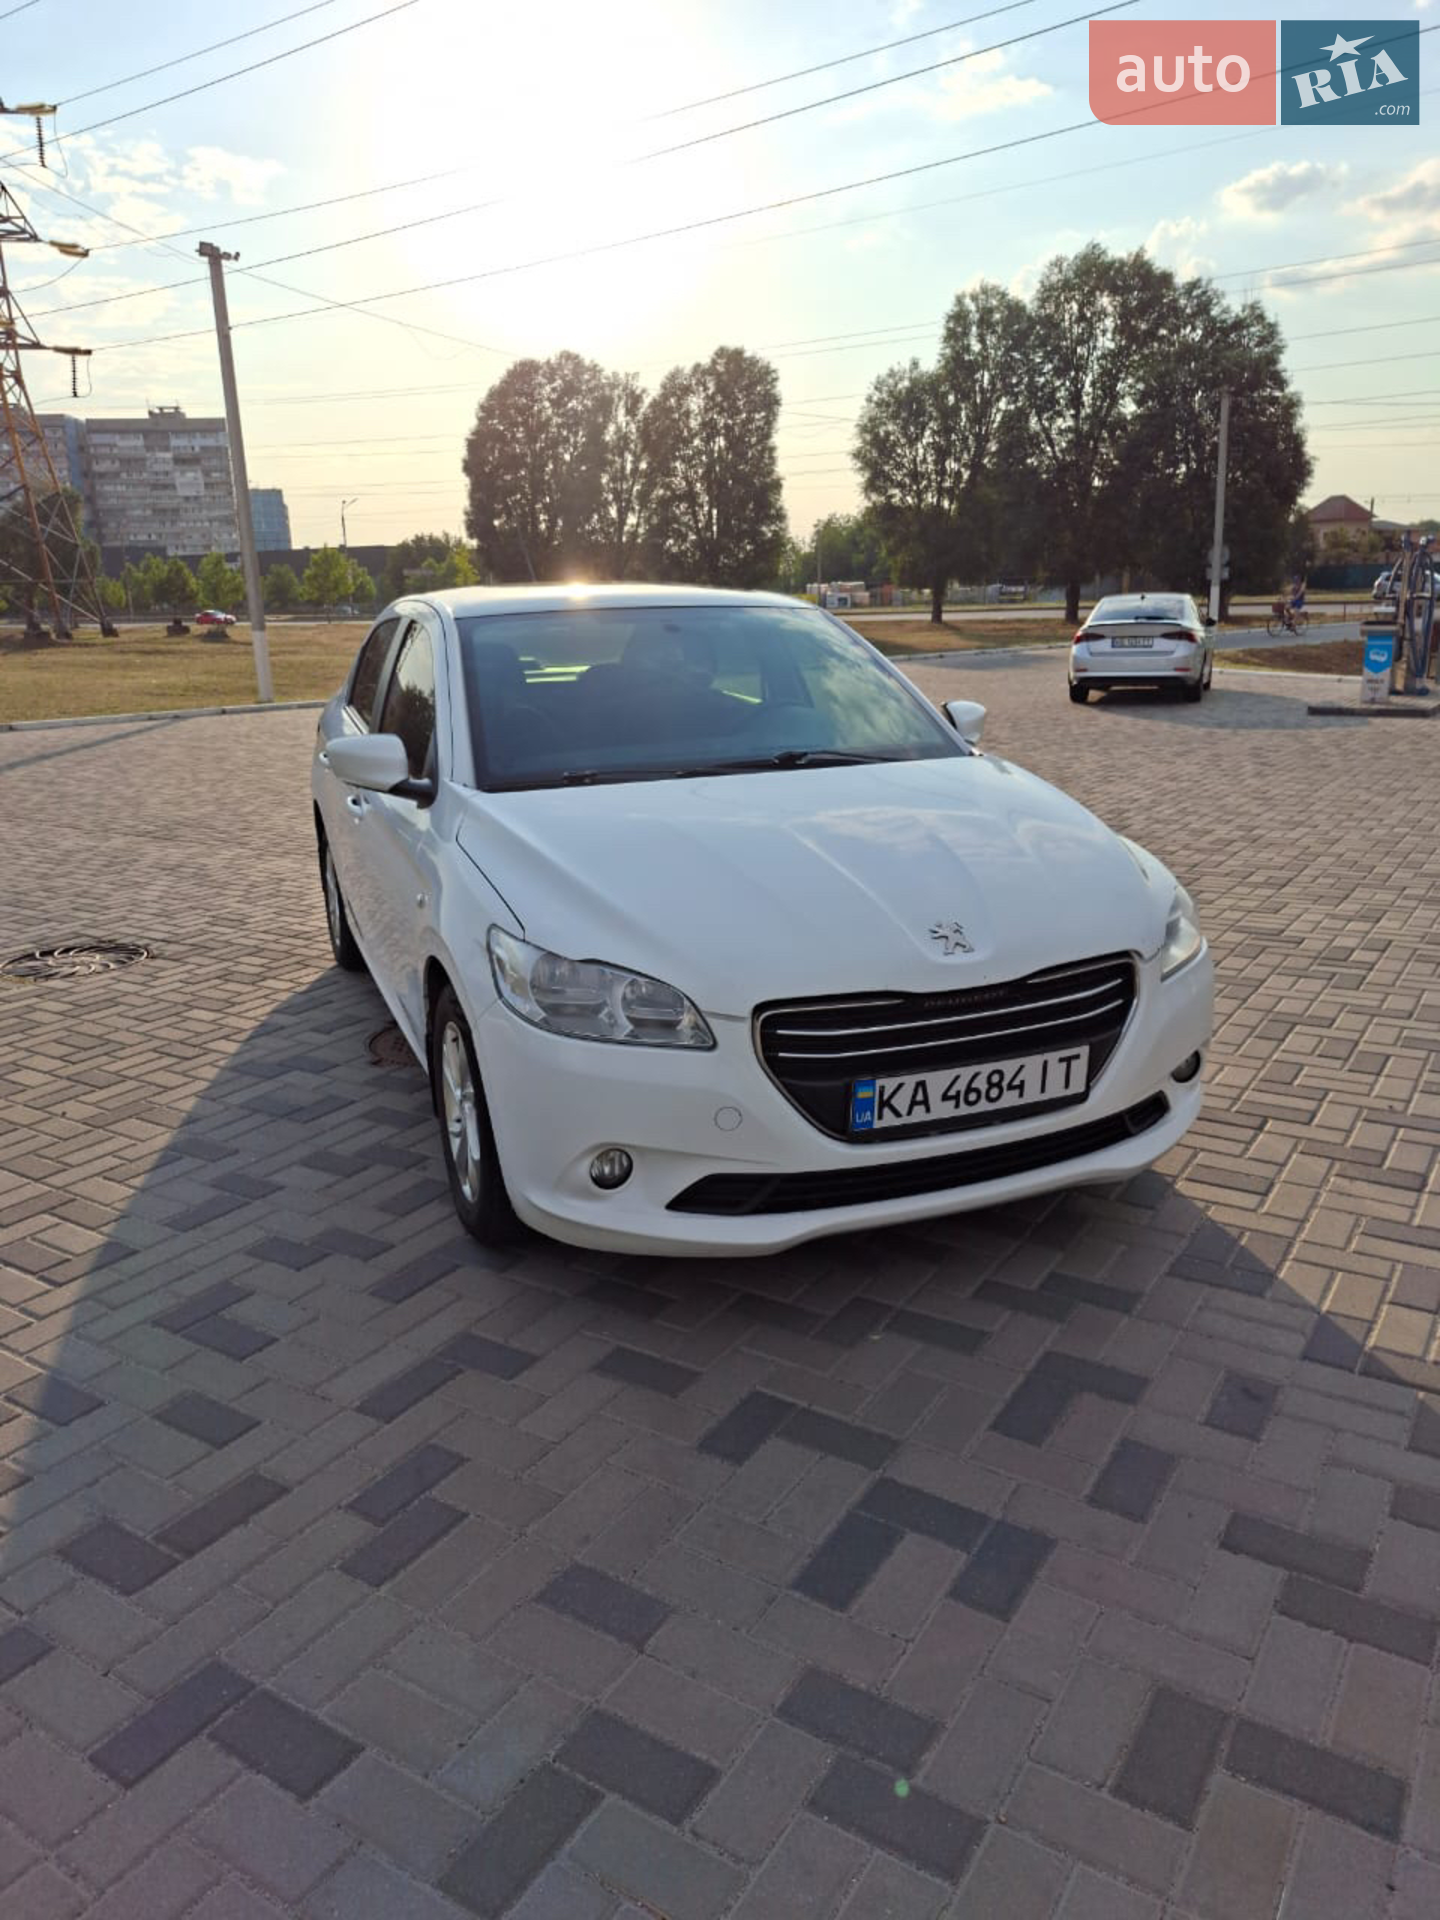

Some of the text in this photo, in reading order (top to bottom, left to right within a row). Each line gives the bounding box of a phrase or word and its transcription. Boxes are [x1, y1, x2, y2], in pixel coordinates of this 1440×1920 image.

[877, 1079, 931, 1120] KA
[941, 1064, 1025, 1109] 4684
[855, 1110, 872, 1123] UA
